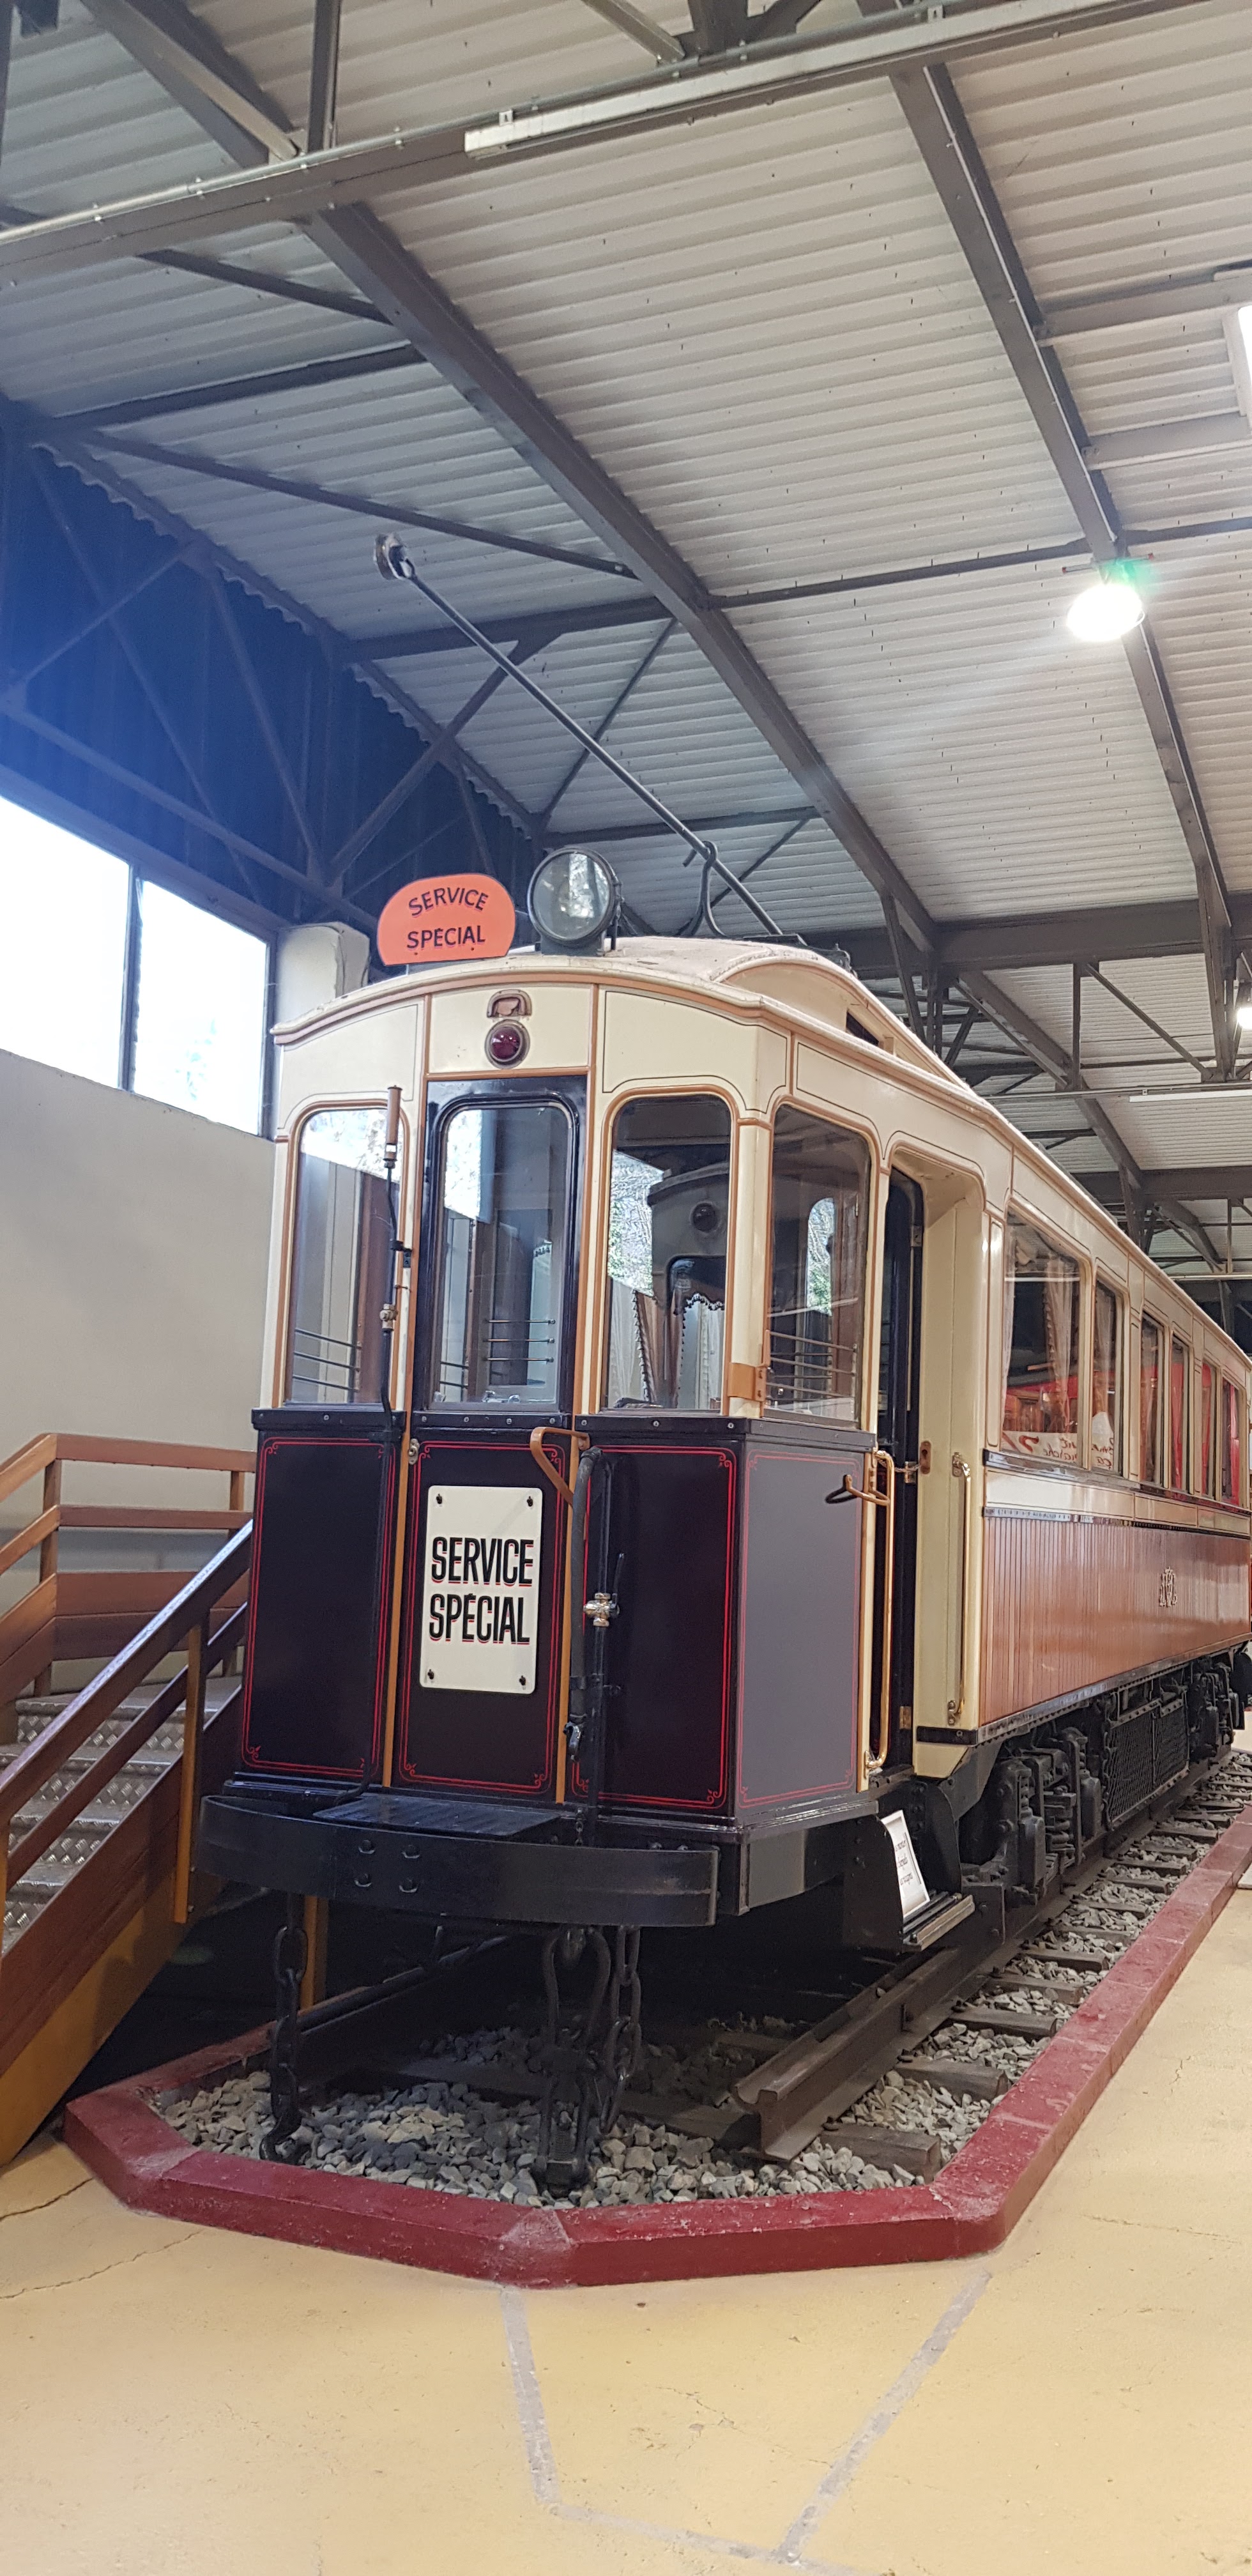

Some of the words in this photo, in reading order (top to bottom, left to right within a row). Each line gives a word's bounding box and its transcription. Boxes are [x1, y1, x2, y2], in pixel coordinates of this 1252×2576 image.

[409, 887, 489, 917] SERVICE
[432, 1537, 534, 1586] SERVICE
[429, 1593, 530, 1644] SPÉCIAL
